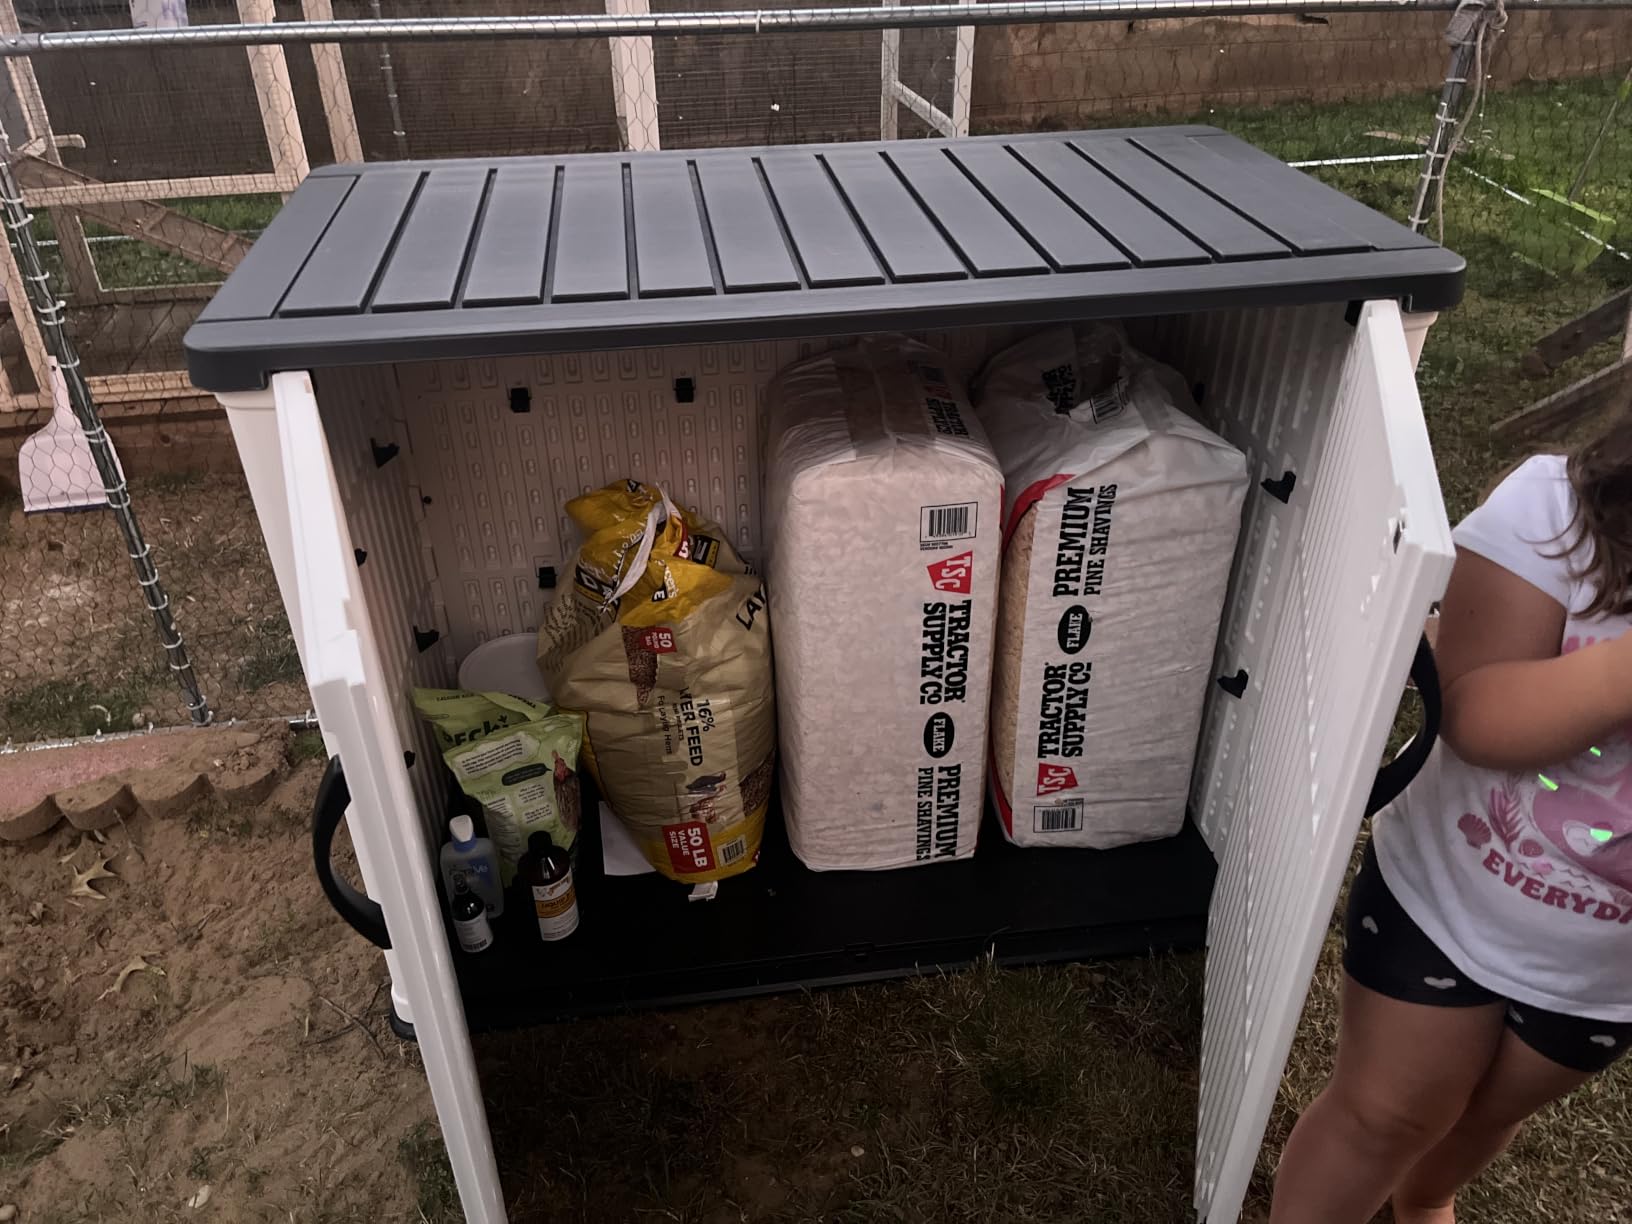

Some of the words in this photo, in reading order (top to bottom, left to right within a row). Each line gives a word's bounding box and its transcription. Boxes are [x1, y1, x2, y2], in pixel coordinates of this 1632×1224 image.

[1088, 483, 1118, 555] SHAVINGS
[1053, 487, 1095, 597] PREMIUM
[935, 555, 972, 590] TSC
[1083, 559, 1105, 596] PINE
[658, 632, 673, 648] 50
[921, 602, 947, 679] SUPPLY
[1067, 613, 1083, 649] FLAKE
[944, 599, 972, 703] TRACTOR
[696, 699, 715, 732] 16%
[1037, 662, 1067, 758] TRACTOR
[1061, 687, 1089, 757] SUPPLY
[686, 725, 704, 767] FEED
[932, 718, 946, 753] FLAKE
[917, 766, 934, 799] PINE
[1038, 768, 1071, 794] TSC
[935, 763, 961, 858] PREMIUM
[669, 831, 680, 849] SIZE
[678, 830, 690, 857] VALUE
[687, 827, 704, 847] 50
[916, 801, 932, 861] SHAVINGS
[692, 848, 708, 868] LB
